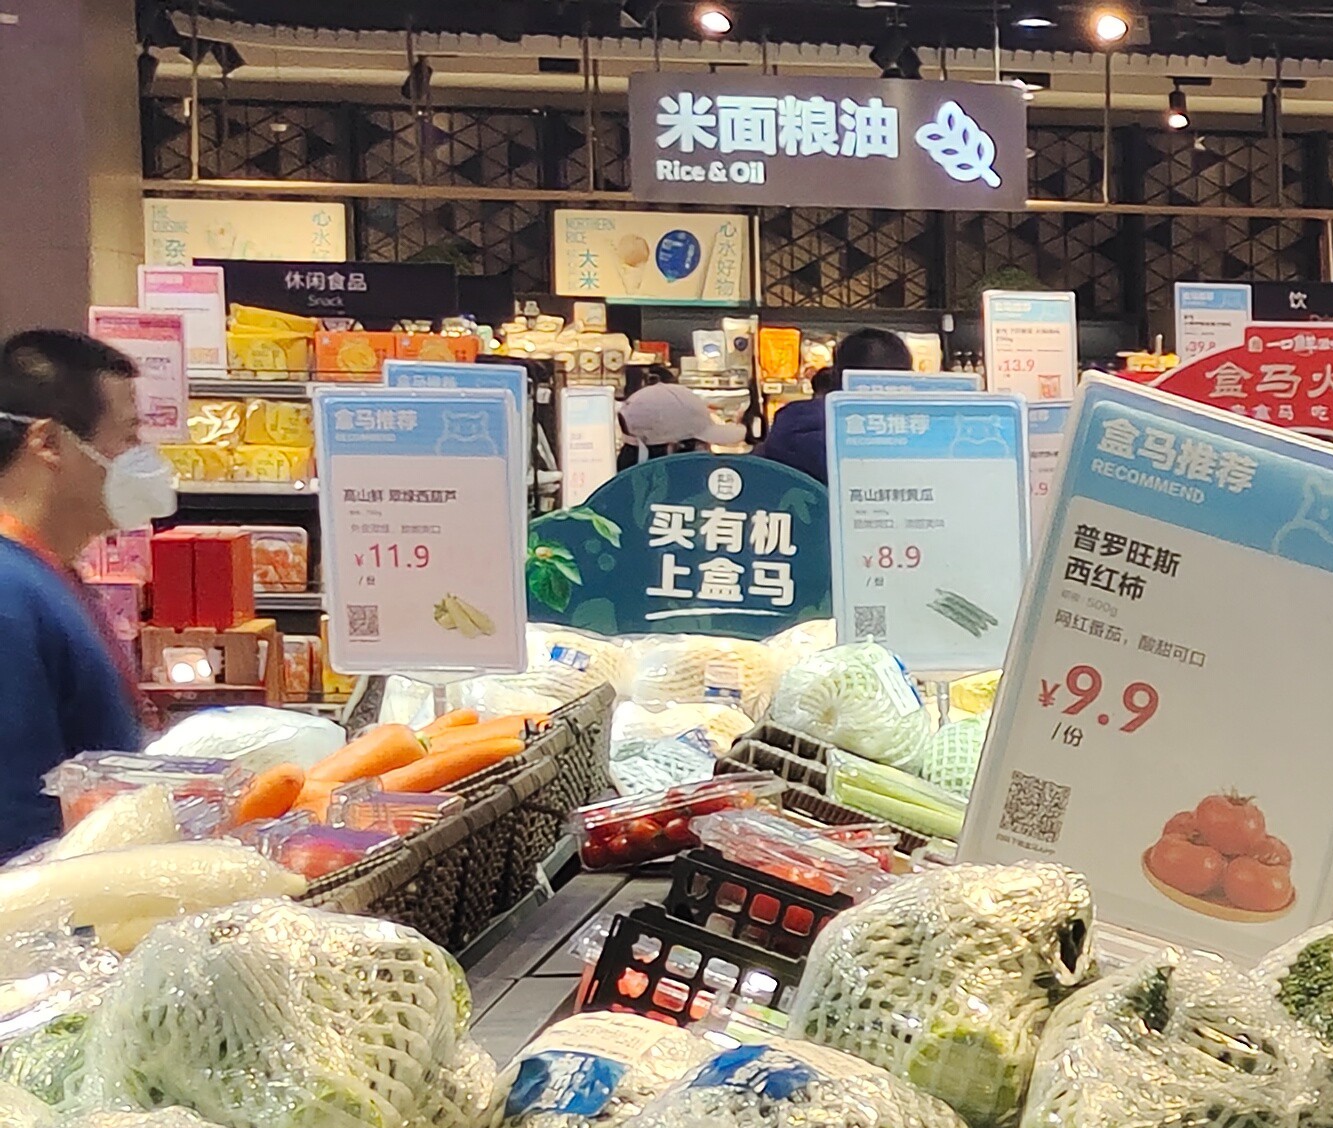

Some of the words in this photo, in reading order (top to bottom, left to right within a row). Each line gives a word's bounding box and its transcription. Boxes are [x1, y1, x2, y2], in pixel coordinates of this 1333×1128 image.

[655, 92, 899, 158] 米面粮油
[655, 160, 705, 182] Rice
[708, 162, 728, 183] &
[729, 161, 766, 184] Oil
[285, 271, 368, 292] 休闲食品
[579, 248, 600, 290] 大米
[334, 408, 418, 431] 盒马推荐
[845, 412, 930, 435] 盒马推荐
[1096, 417, 1260, 494] 盒马推荐
[1090, 457, 1207, 504] RECOMMEND
[649, 503, 797, 557] 买有机
[1073, 523, 1183, 578] 普罗旺斯
[645, 552, 796, 607] 上盒马
[1063, 555, 1147, 602] 西红柿
